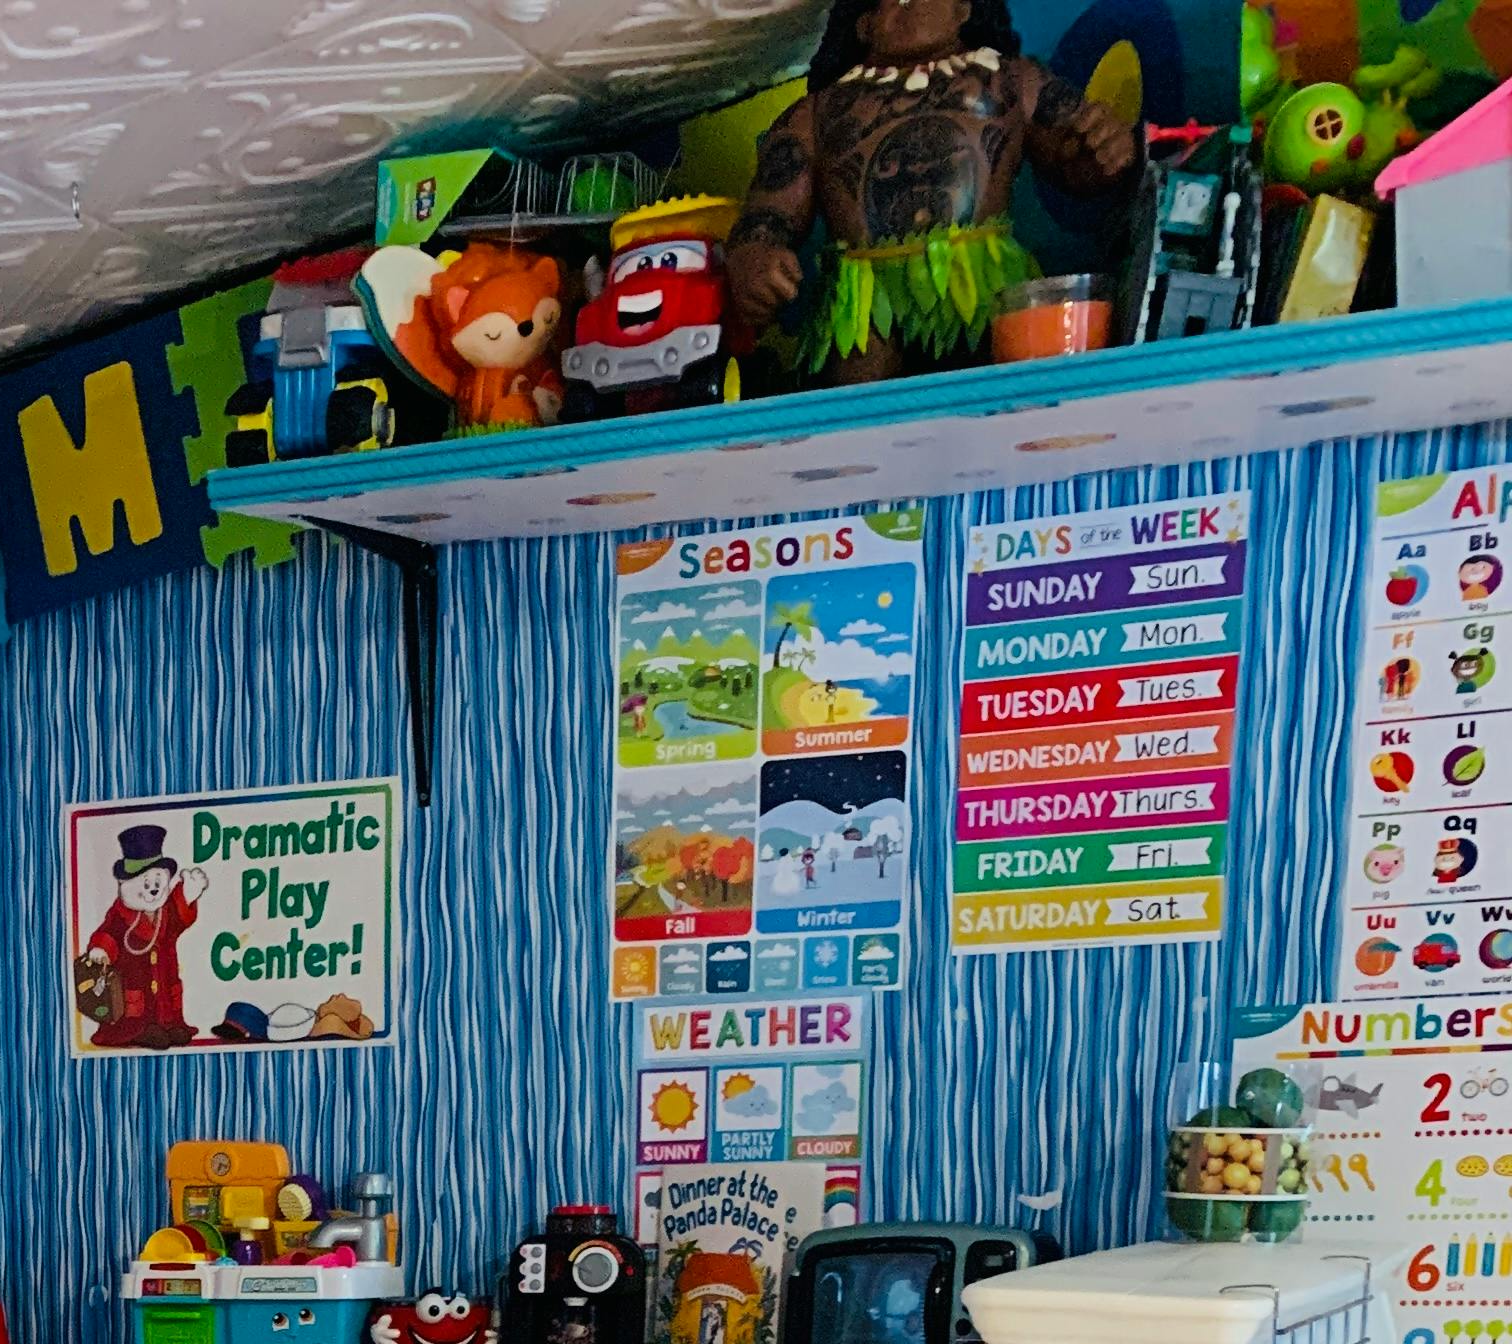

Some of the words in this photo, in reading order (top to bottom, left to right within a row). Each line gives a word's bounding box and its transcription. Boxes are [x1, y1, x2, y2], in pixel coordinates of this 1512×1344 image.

[18, 361, 163, 576] M
[997, 526, 1072, 562] DAYS
[1081, 529, 1096, 542] of
[1100, 526, 1122, 541] the
[1131, 507, 1220, 544] WEEK
[1396, 543, 1426, 560] Aa
[1469, 532, 1498, 552] Bb
[988, 571, 1102, 611] SUNDAY
[1147, 563, 1205, 588] Sun.
[977, 627, 1107, 668] MONDAY
[1141, 622, 1204, 646] Mon.
[1392, 631, 1414, 649] Ff
[1463, 623, 1494, 643] Gg
[978, 683, 1101, 721] TUESDAY
[1136, 676, 1201, 702] Tues.
[656, 741, 716, 759] Spring
[795, 726, 872, 748] Summer
[966, 740, 1111, 774] WEDNESDAY
[1135, 732, 1194, 757] Wed.
[1381, 728, 1411, 746] Kk
[1457, 721, 1475, 739] Ll
[964, 790, 1109, 828] THURSDAY
[1122, 789, 1204, 813] Thurs.
[192, 800, 380, 864] Dramatic
[1373, 822, 1400, 841] Pp
[1444, 816, 1477, 834] Qq
[977, 847, 1084, 880] FRIDAY
[1137, 844, 1178, 867] Fri.
[241, 866, 330, 930] Play
[959, 900, 1101, 933] SATURDAY
[665, 918, 696, 934] Fall
[797, 909, 855, 927] Winter
[1367, 915, 1396, 930] Uu
[1426, 911, 1455, 925] Vv
[211, 923, 364, 982] Center!
[650, 1003, 852, 1051] WEATHER
[1420, 1073, 1452, 1122] 2
[644, 1144, 701, 1161] SUNNY
[721, 1132, 775, 1145] PARTLY
[723, 1147, 774, 1160] SUNNY
[797, 1140, 853, 1155] CLOUDY
[668, 1177, 725, 1210] Dinner
[728, 1170, 746, 1197] at
[750, 1173, 778, 1208] the
[1415, 1159, 1446, 1207] 4
[663, 1203, 717, 1240] Panda
[720, 1199, 779, 1236] Palace
[1408, 1244, 1439, 1291] 6
